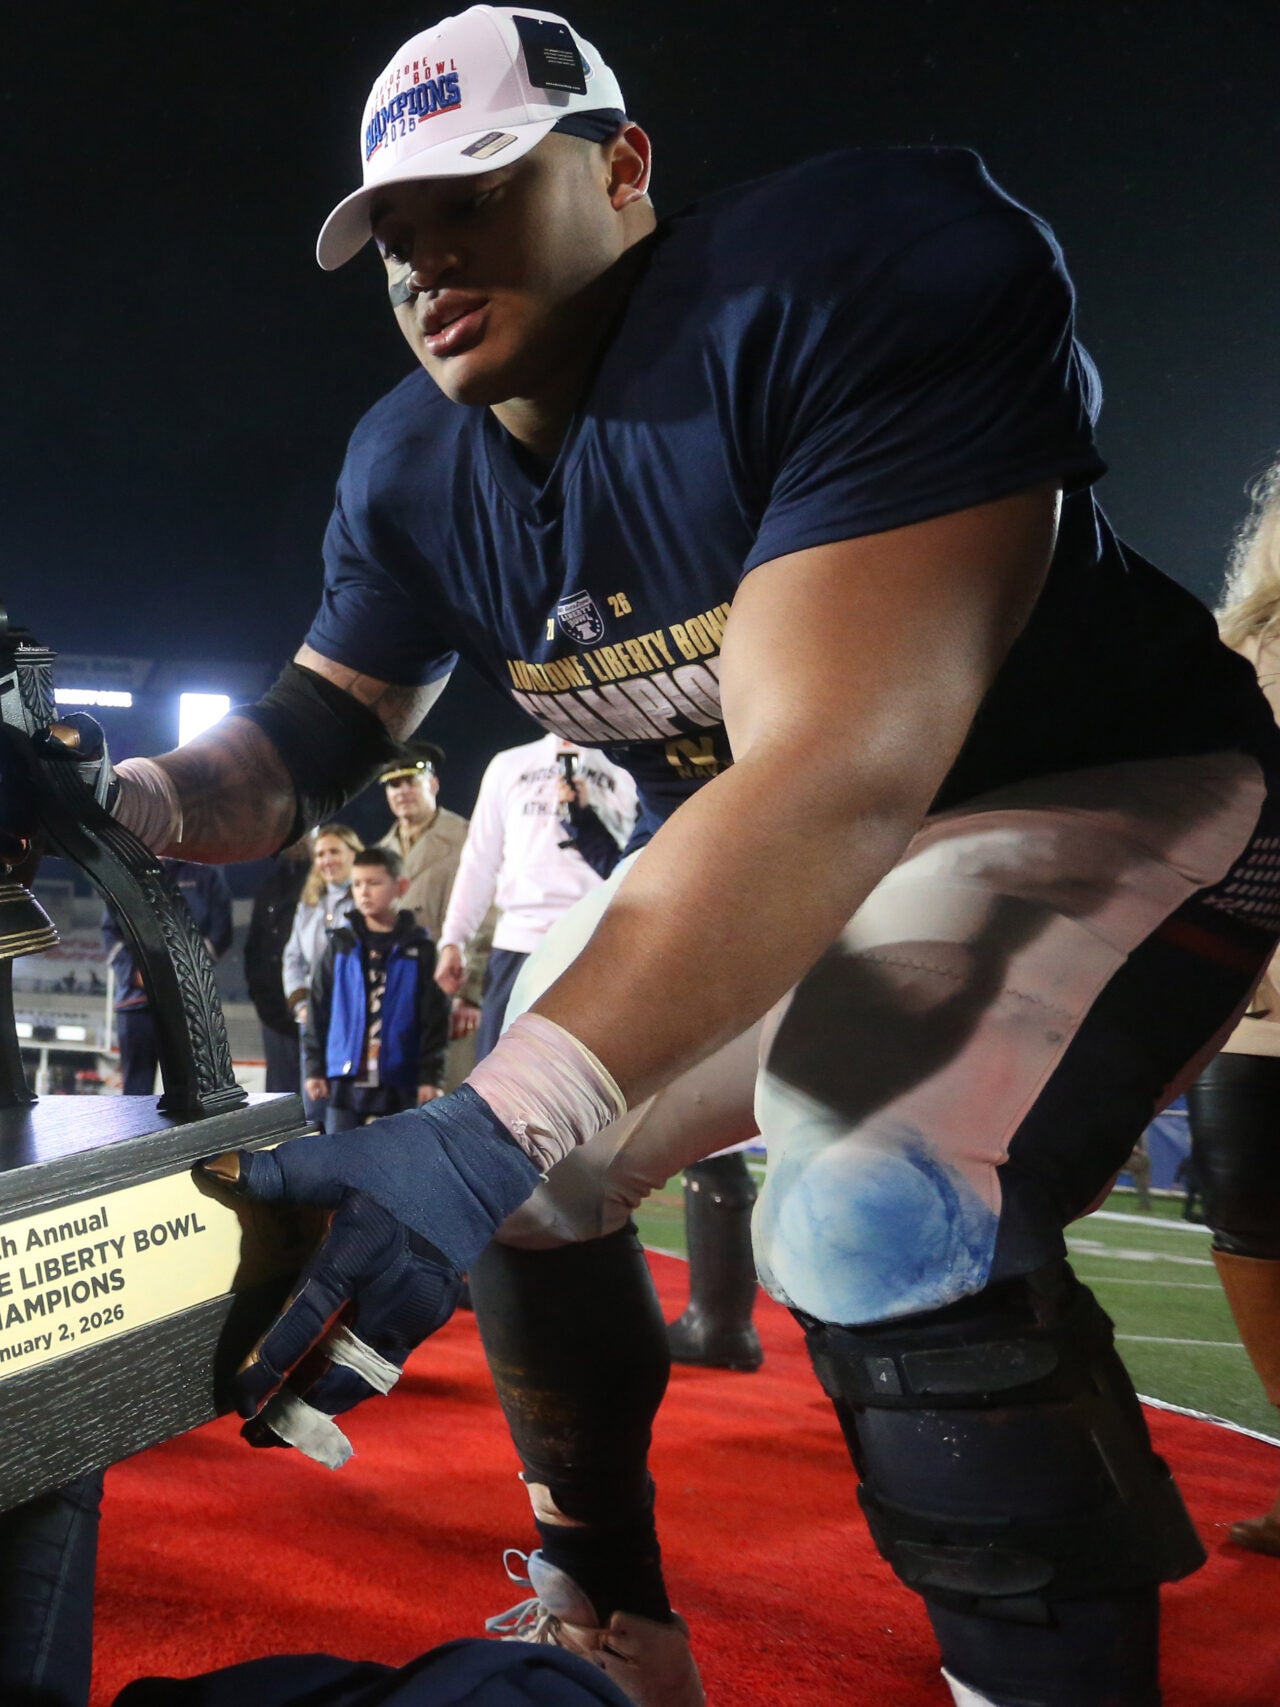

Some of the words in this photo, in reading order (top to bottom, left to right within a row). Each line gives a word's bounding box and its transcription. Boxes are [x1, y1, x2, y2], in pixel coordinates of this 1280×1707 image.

[412, 58, 457, 85] BOWL
[383, 117, 416, 149] 2025
[607, 592, 633, 618] 26
[583, 629, 676, 682] LIBERTY
[25, 1205, 110, 1252] Annual
[19, 1235, 126, 1291] LIBERTY
[134, 1211, 207, 1253] BOWL
[58, 1321, 76, 1343] 2,
[79, 1304, 125, 1335] 2026
